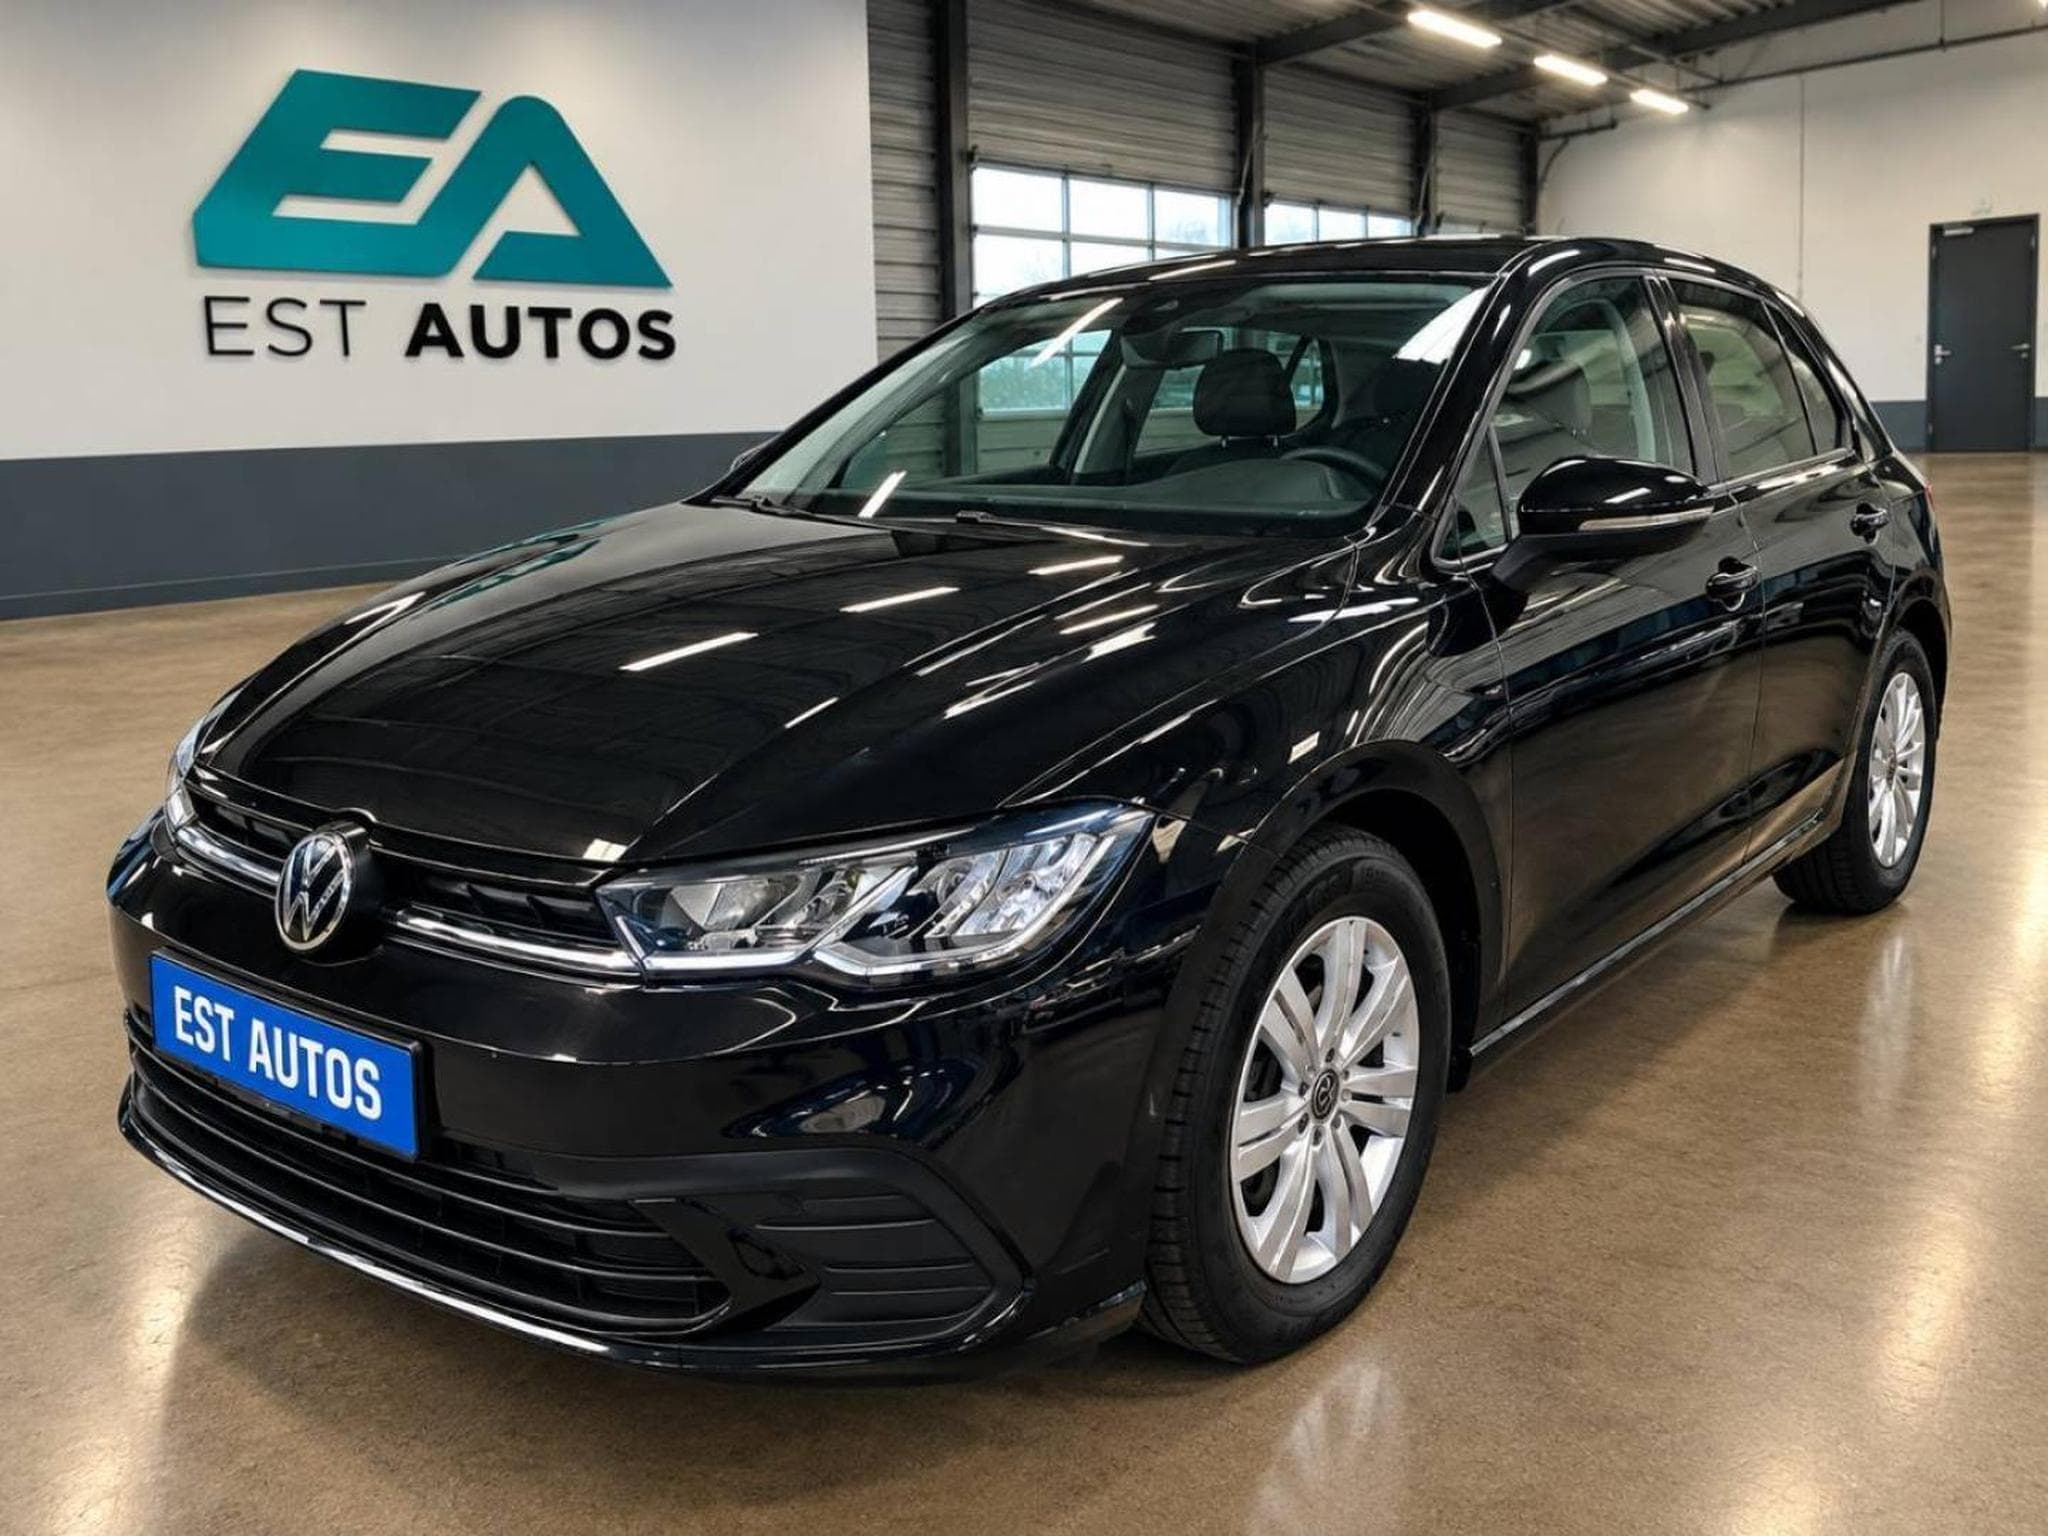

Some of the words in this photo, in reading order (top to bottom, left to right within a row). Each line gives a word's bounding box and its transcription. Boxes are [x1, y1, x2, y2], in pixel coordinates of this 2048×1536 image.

[193, 69, 672, 288] EA
[204, 296, 367, 357] EST
[405, 303, 676, 361] AUTOS
[174, 986, 234, 1062] EST
[249, 1018, 382, 1121] AUTOS
